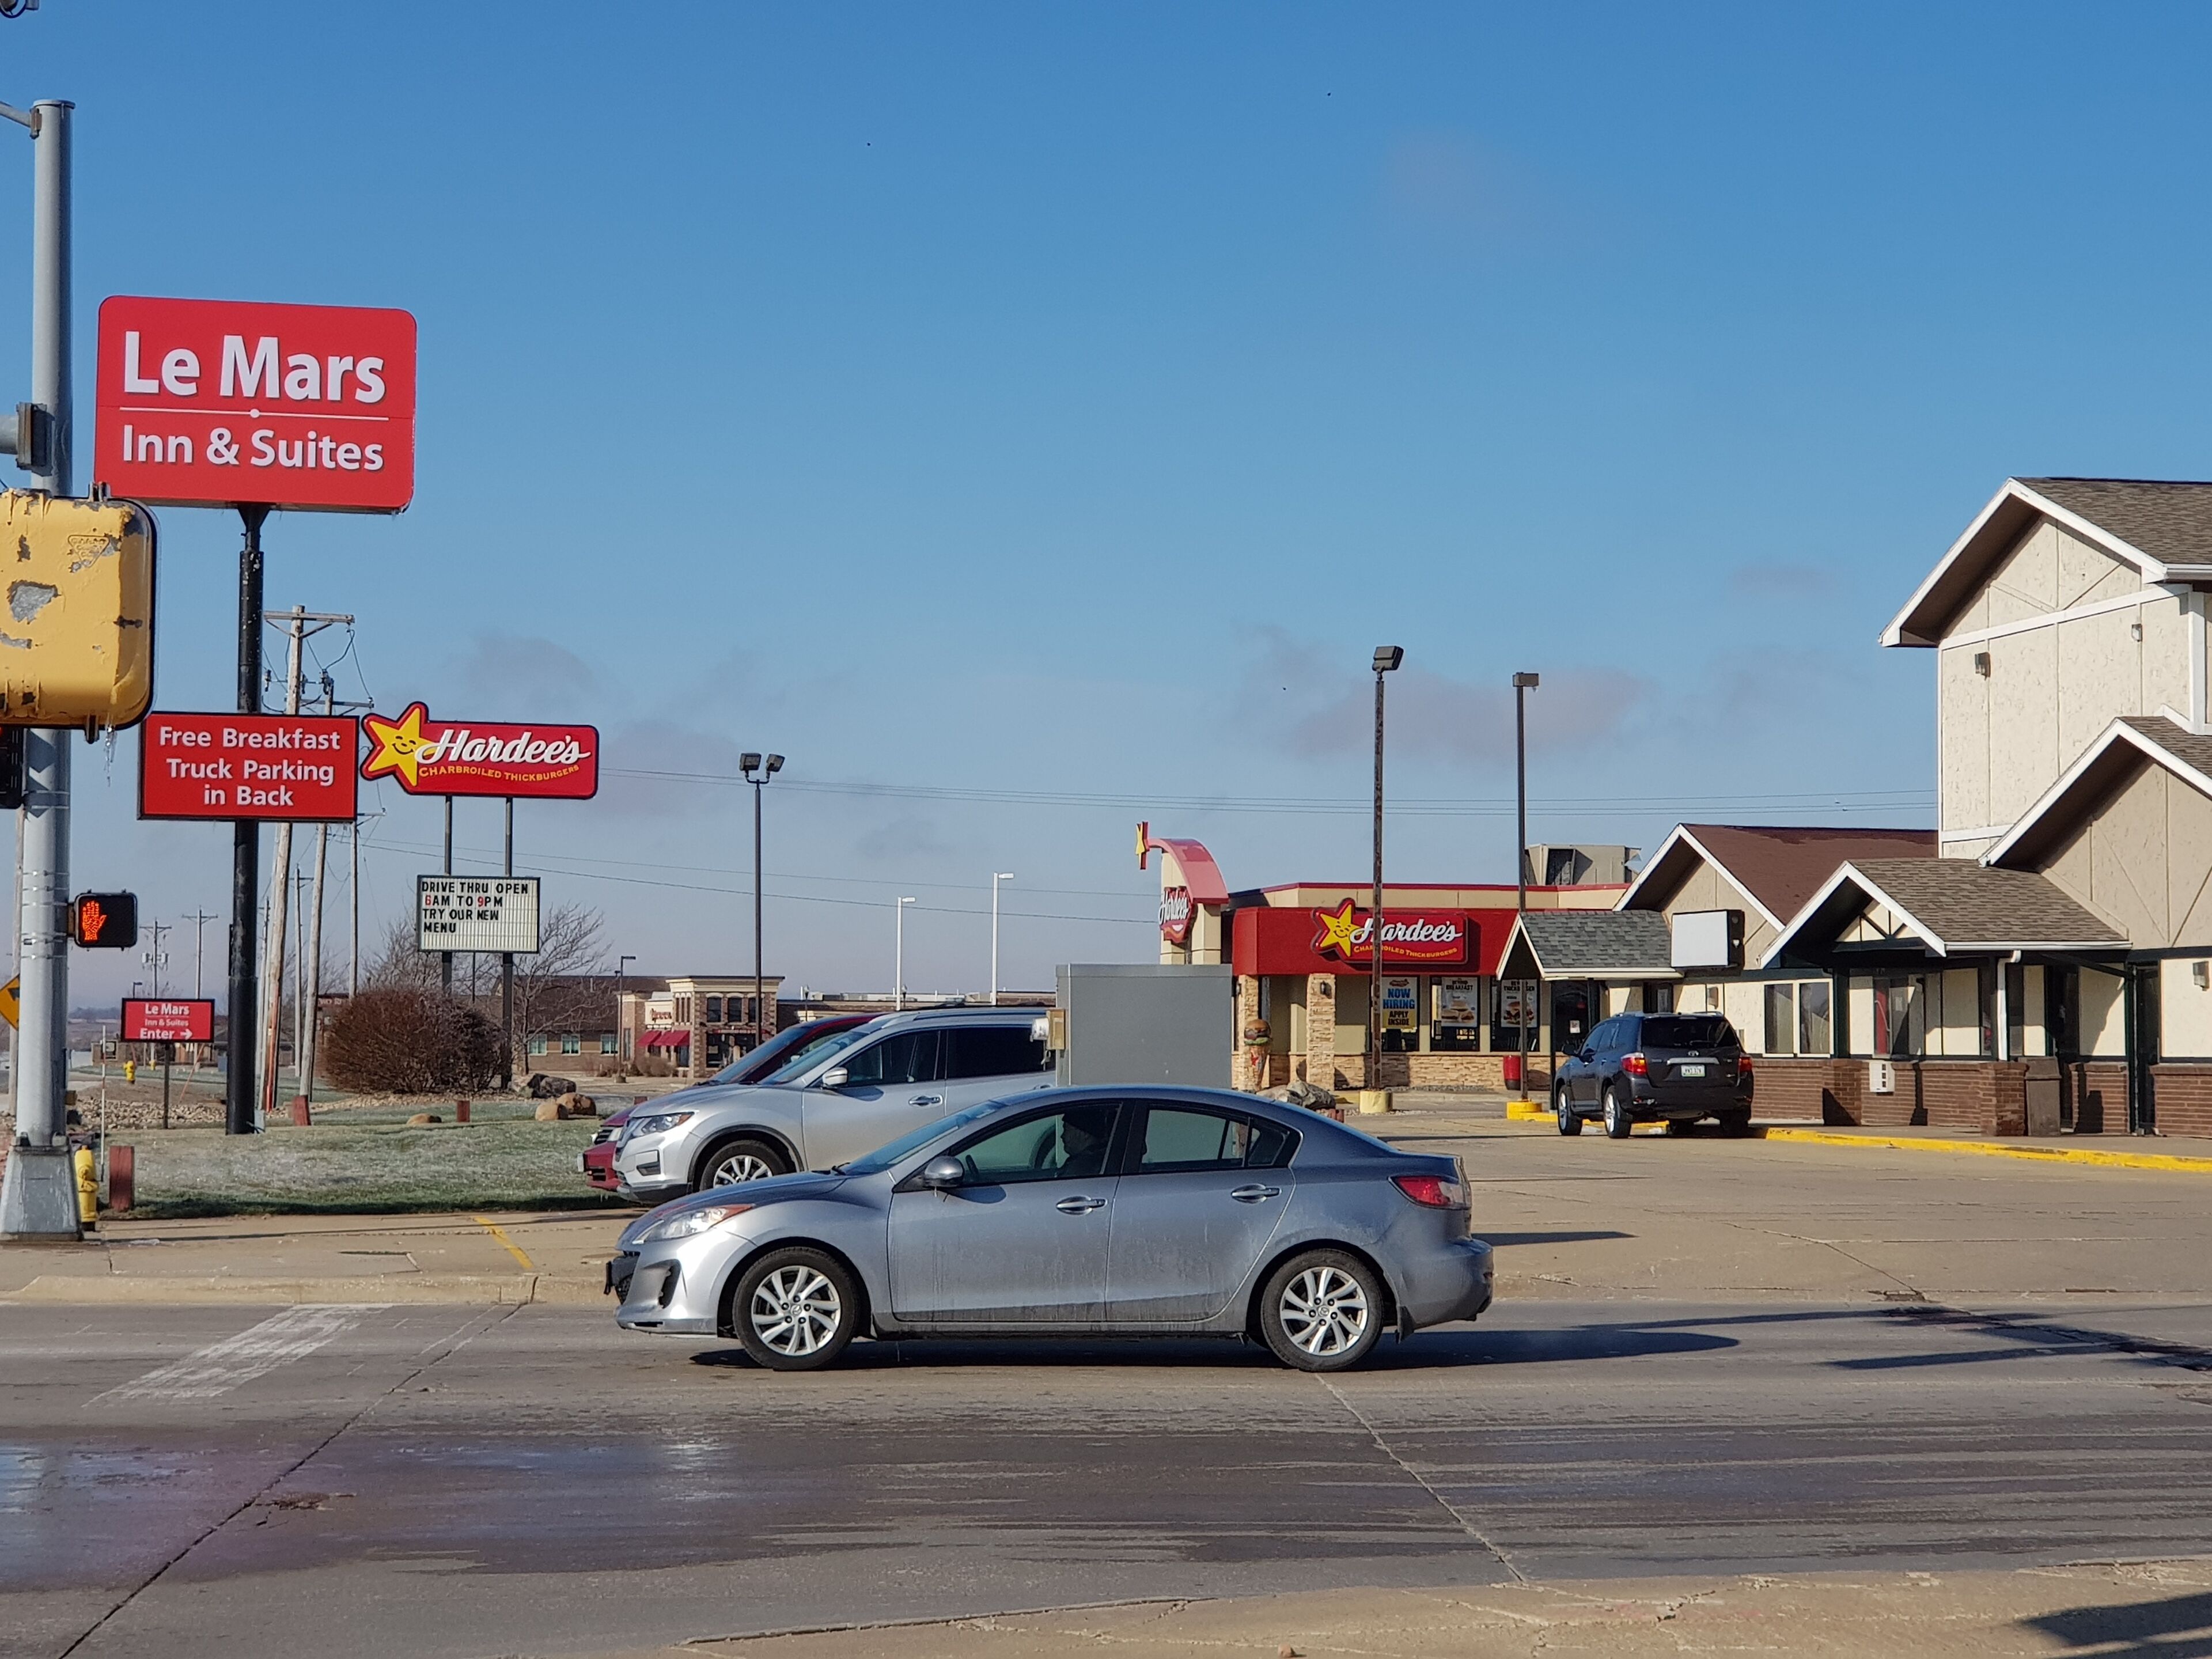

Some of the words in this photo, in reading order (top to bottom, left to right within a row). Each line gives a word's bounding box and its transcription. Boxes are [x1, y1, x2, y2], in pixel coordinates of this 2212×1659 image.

[124, 330, 200, 396] Le
[219, 335, 385, 403] Mars
[123, 424, 194, 463] Inn
[206, 427, 240, 465] &
[250, 429, 384, 471] Suites
[160, 726, 211, 747] Free
[222, 728, 340, 750] Breakfast
[414, 729, 591, 764] Hardee's
[166, 758, 233, 779] Truck
[243, 759, 334, 786] Parking
[419, 766, 501, 779] CHARBROILED
[504, 765, 579, 782] THICKBURGERS
[204, 784, 225, 805] in
[237, 785, 294, 806] Back
[421, 881, 455, 893] DRIVE
[460, 882, 488, 893] THRU
[495, 883, 528, 894] OPEN
[425, 895, 450, 906] 6AM
[457, 896, 474, 906] TO
[478, 896, 502, 907] 9PM
[422, 908, 445, 919] TRY
[449, 909, 472, 920] OUR
[477, 910, 499, 921] NEW
[423, 922, 456, 933] MENU
[1350, 918, 1463, 944] Hardee's
[1354, 945, 1404, 954] CHAROILED
[1388, 988, 1410, 998] NOW
[145, 1003, 158, 1014] Le
[161, 1004, 190, 1015] Mars
[1383, 999, 1415, 1009] HIRING
[140, 1028, 175, 1039] Enter
